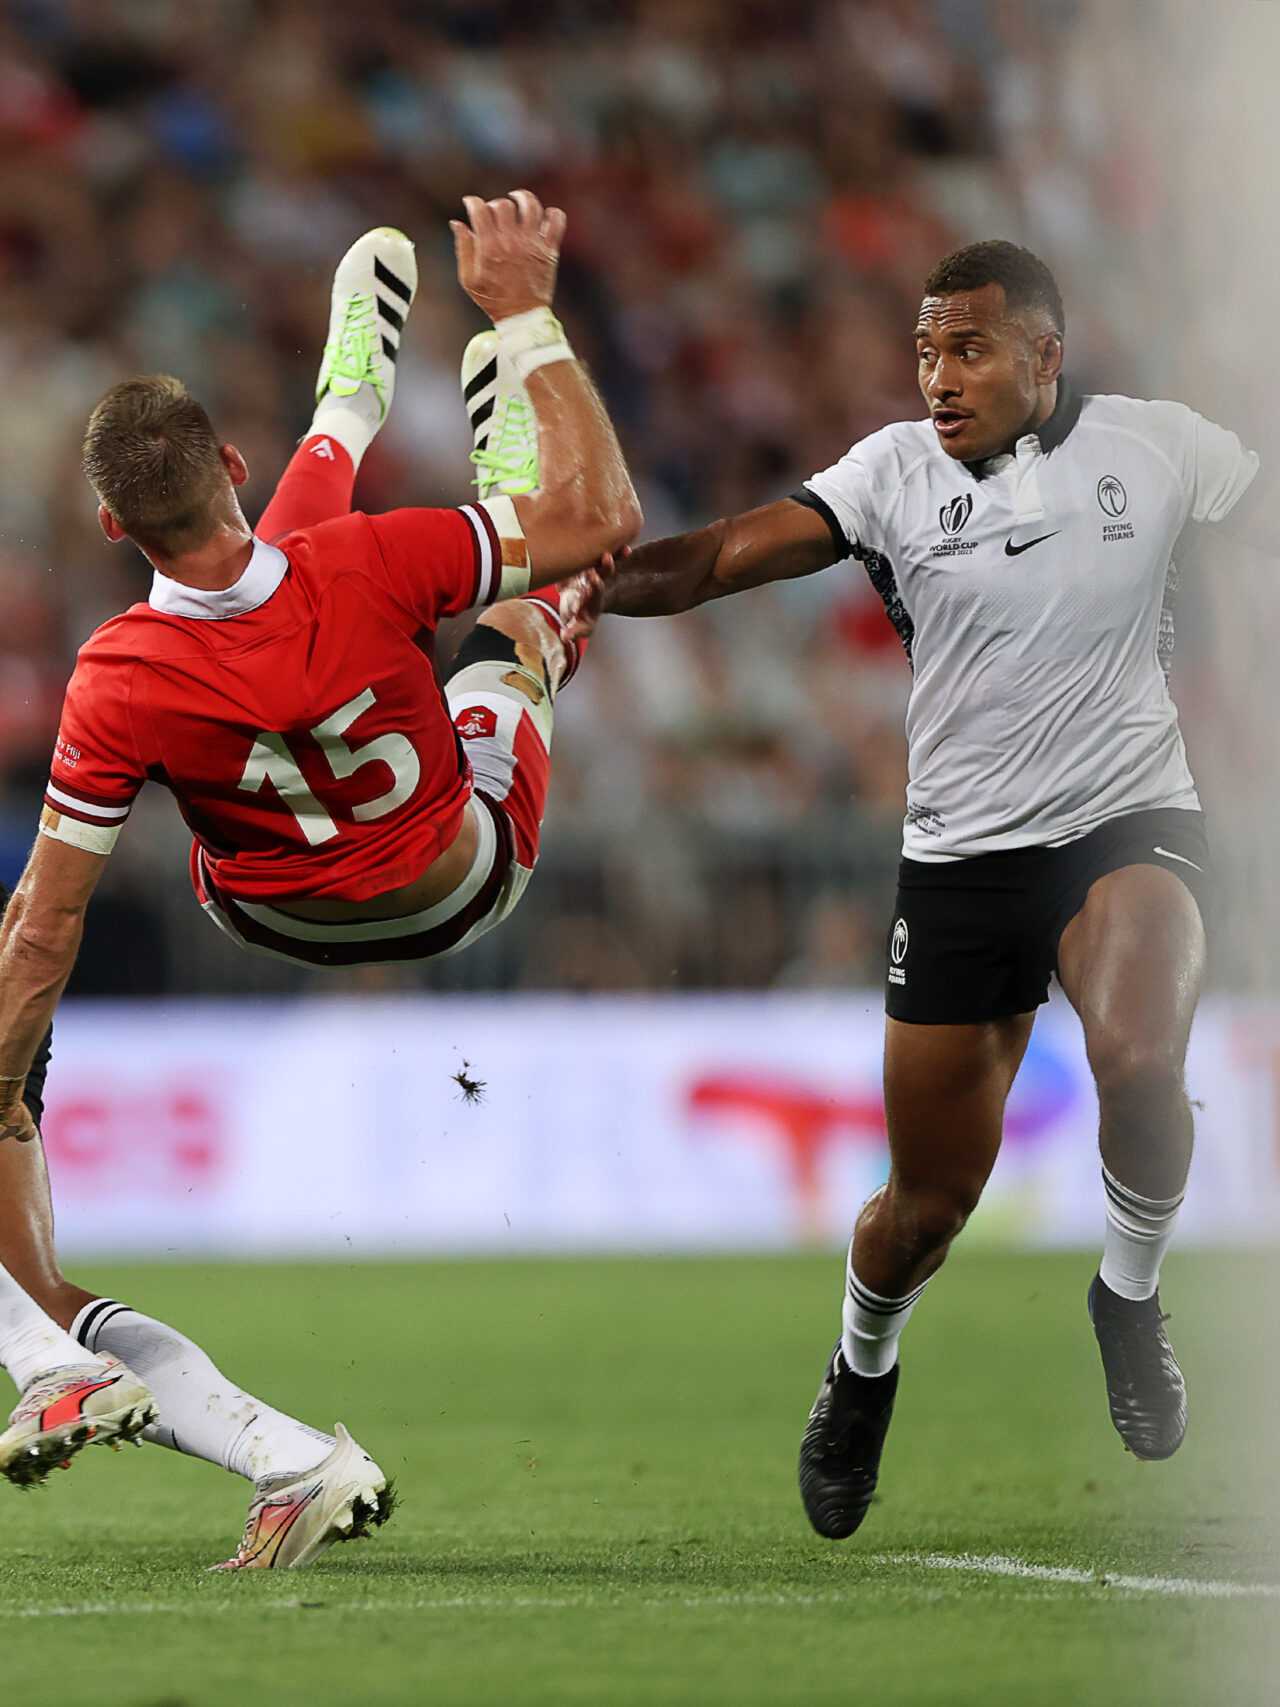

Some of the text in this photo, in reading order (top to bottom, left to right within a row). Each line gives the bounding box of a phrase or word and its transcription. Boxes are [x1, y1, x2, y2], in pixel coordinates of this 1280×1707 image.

[1103, 523, 1133, 533] FLYING
[1103, 531, 1135, 542] FIJIANS
[929, 541, 978, 552] WORLD CUP
[237, 687, 421, 846] 15
